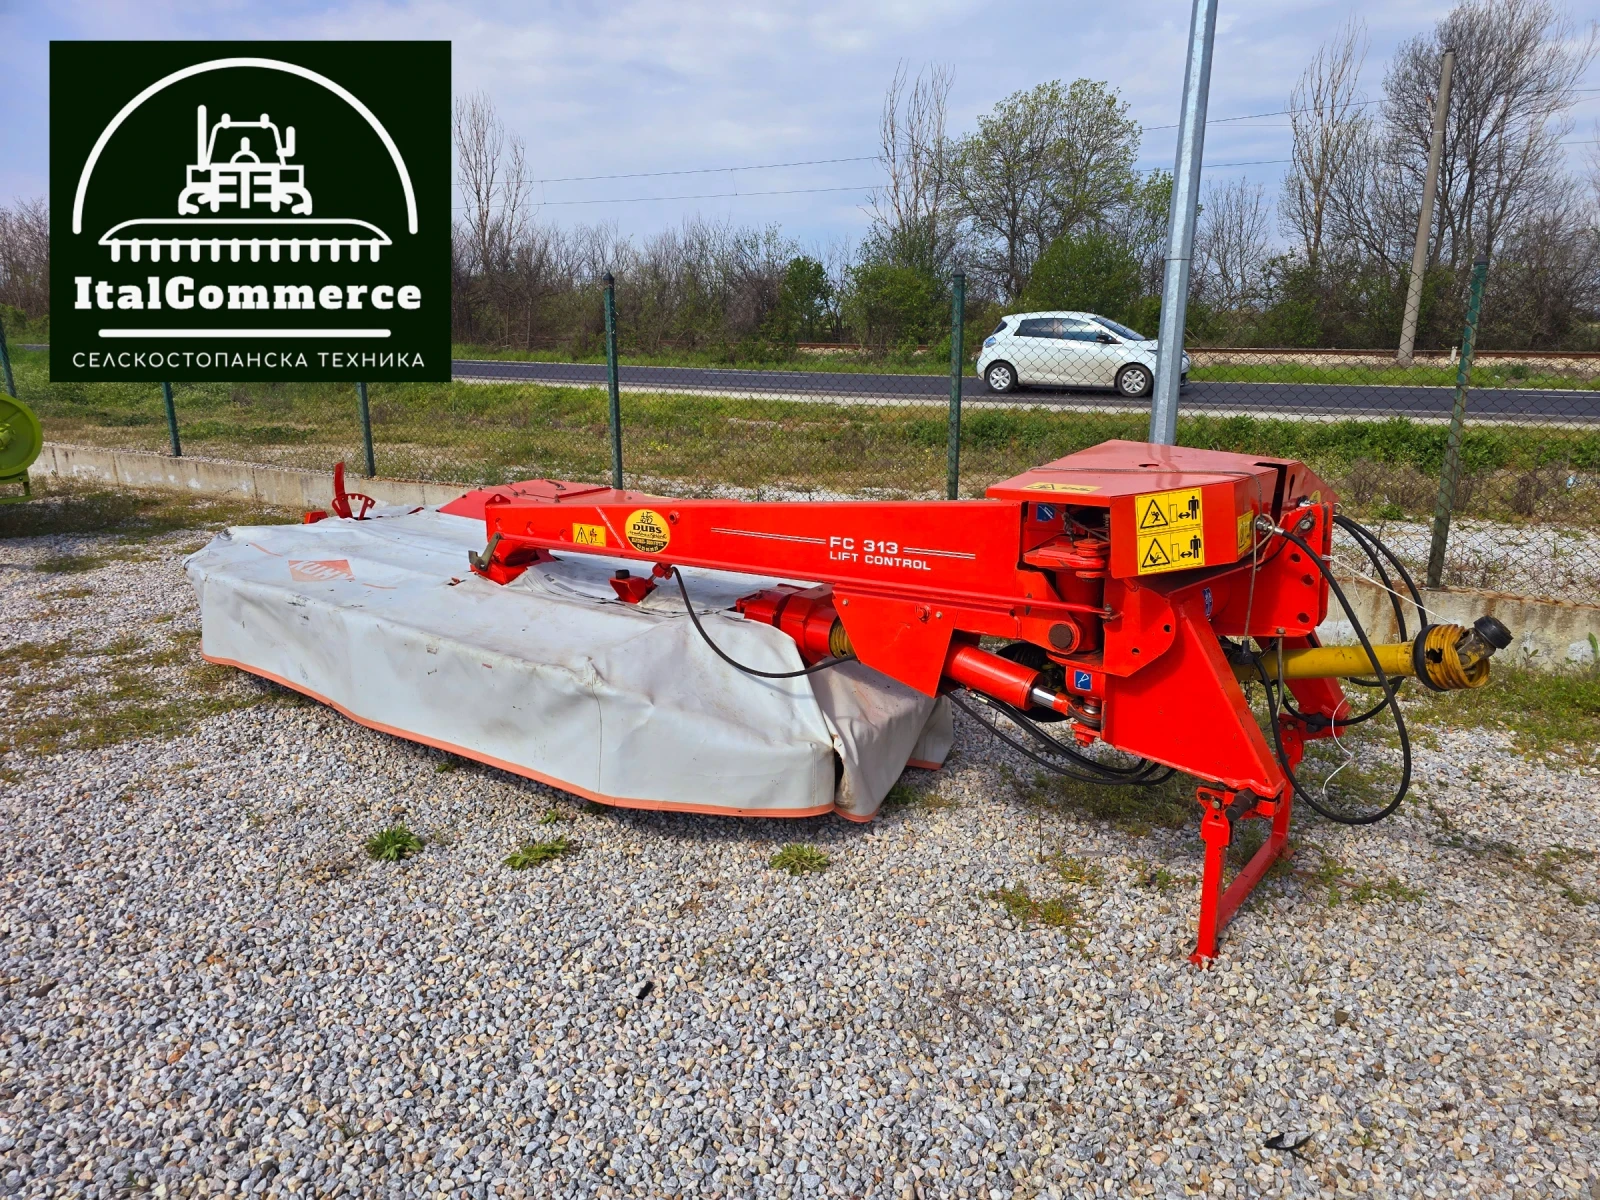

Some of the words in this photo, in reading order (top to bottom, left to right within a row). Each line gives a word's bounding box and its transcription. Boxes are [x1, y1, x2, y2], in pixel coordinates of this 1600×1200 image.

[632, 523, 662, 534] DUBS
[829, 536, 855, 550] FC
[863, 539, 899, 555] 313
[829, 551, 859, 562] LIFT
[864, 554, 932, 571] CONTROL
